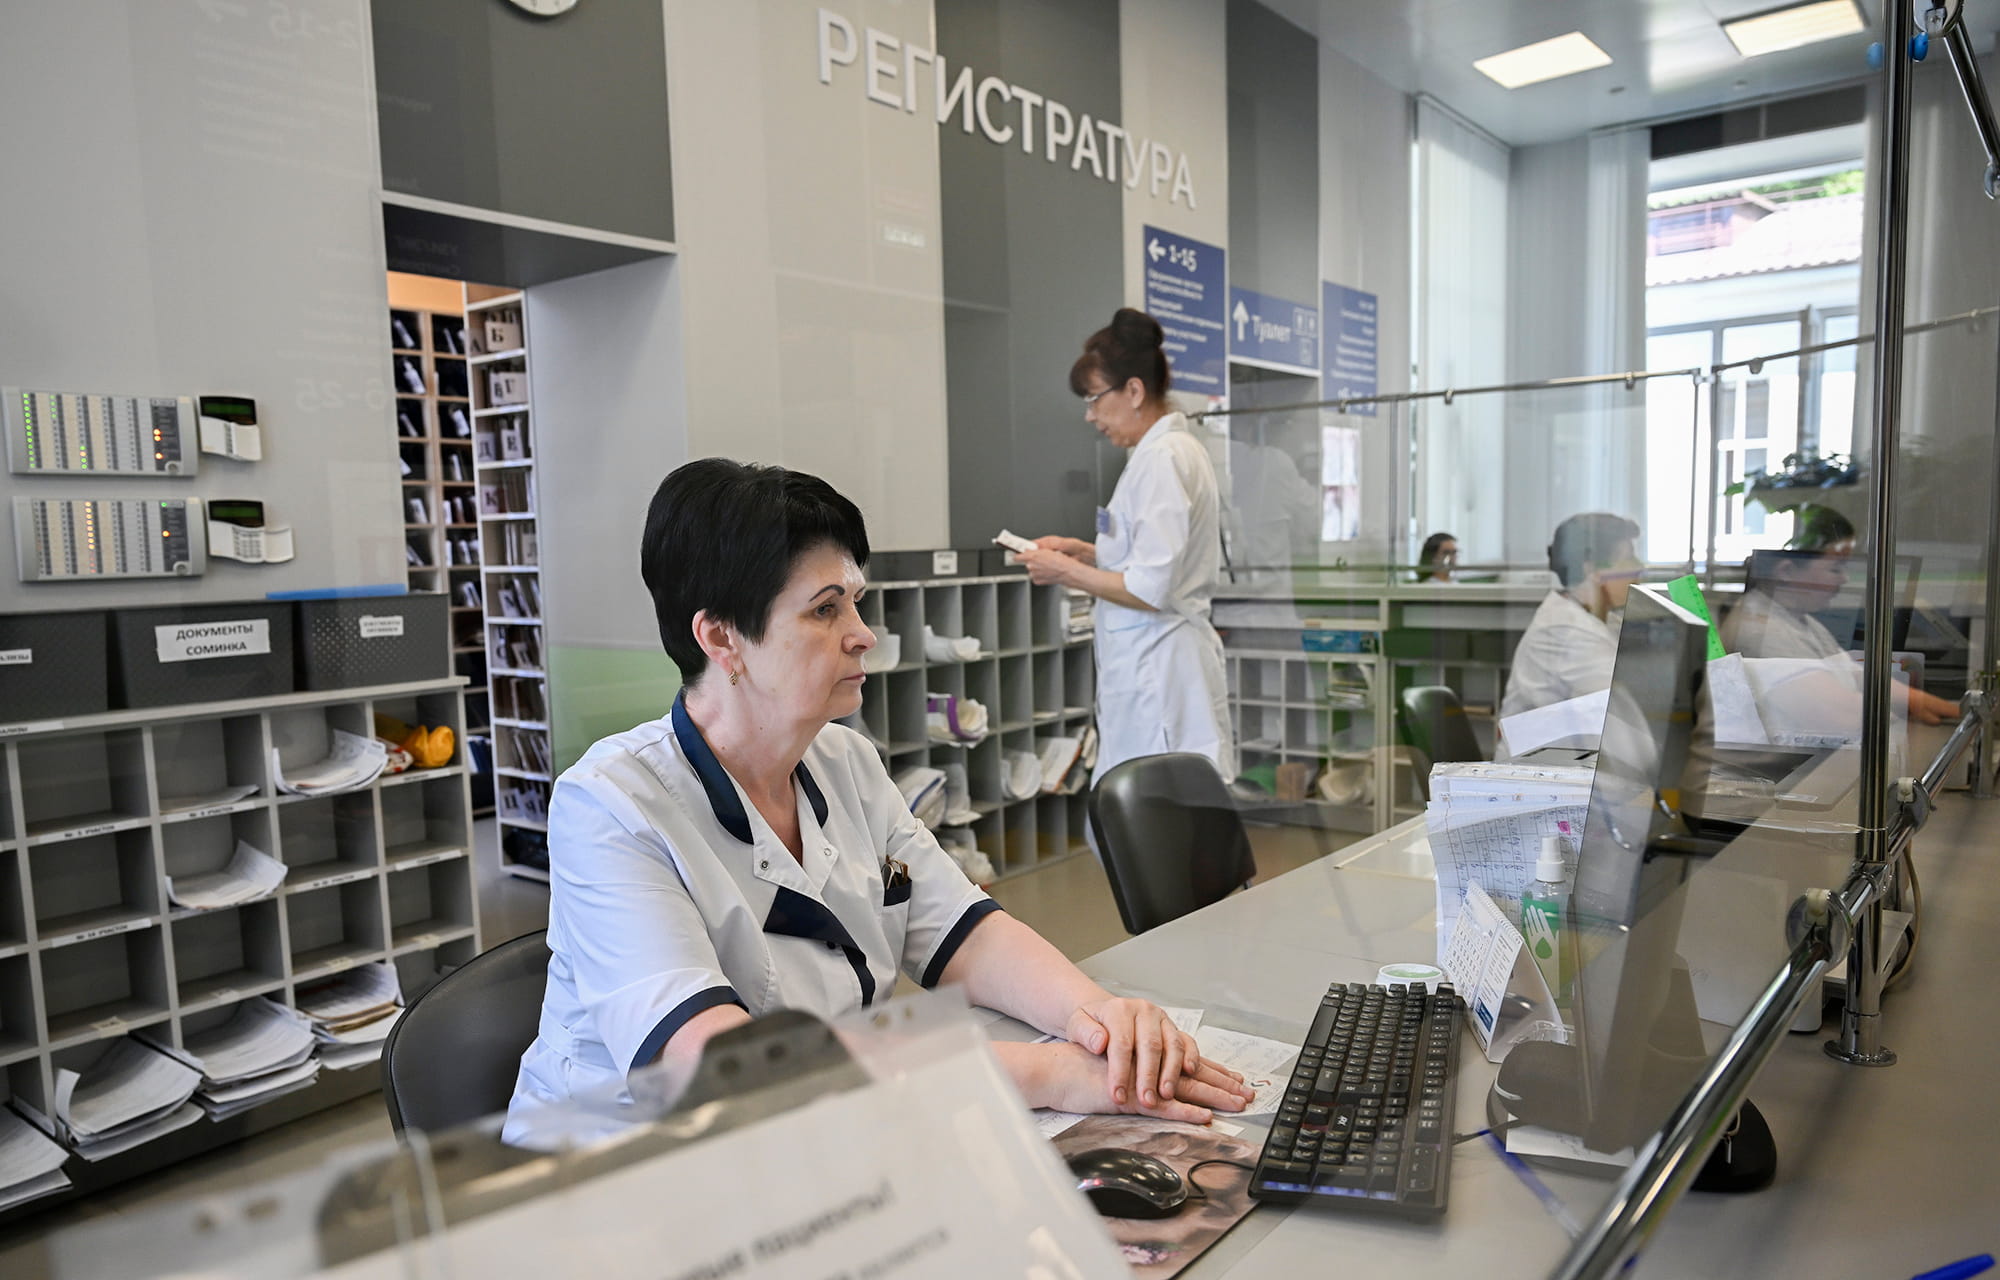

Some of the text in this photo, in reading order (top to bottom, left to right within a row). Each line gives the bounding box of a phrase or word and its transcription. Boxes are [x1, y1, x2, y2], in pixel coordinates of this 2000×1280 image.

[817, 7, 1197, 209] РЕГИСТРАТУРА
[176, 624, 254, 641] ДОКУМЕНТЫ
[186, 641, 248, 656] СОМИНКА
